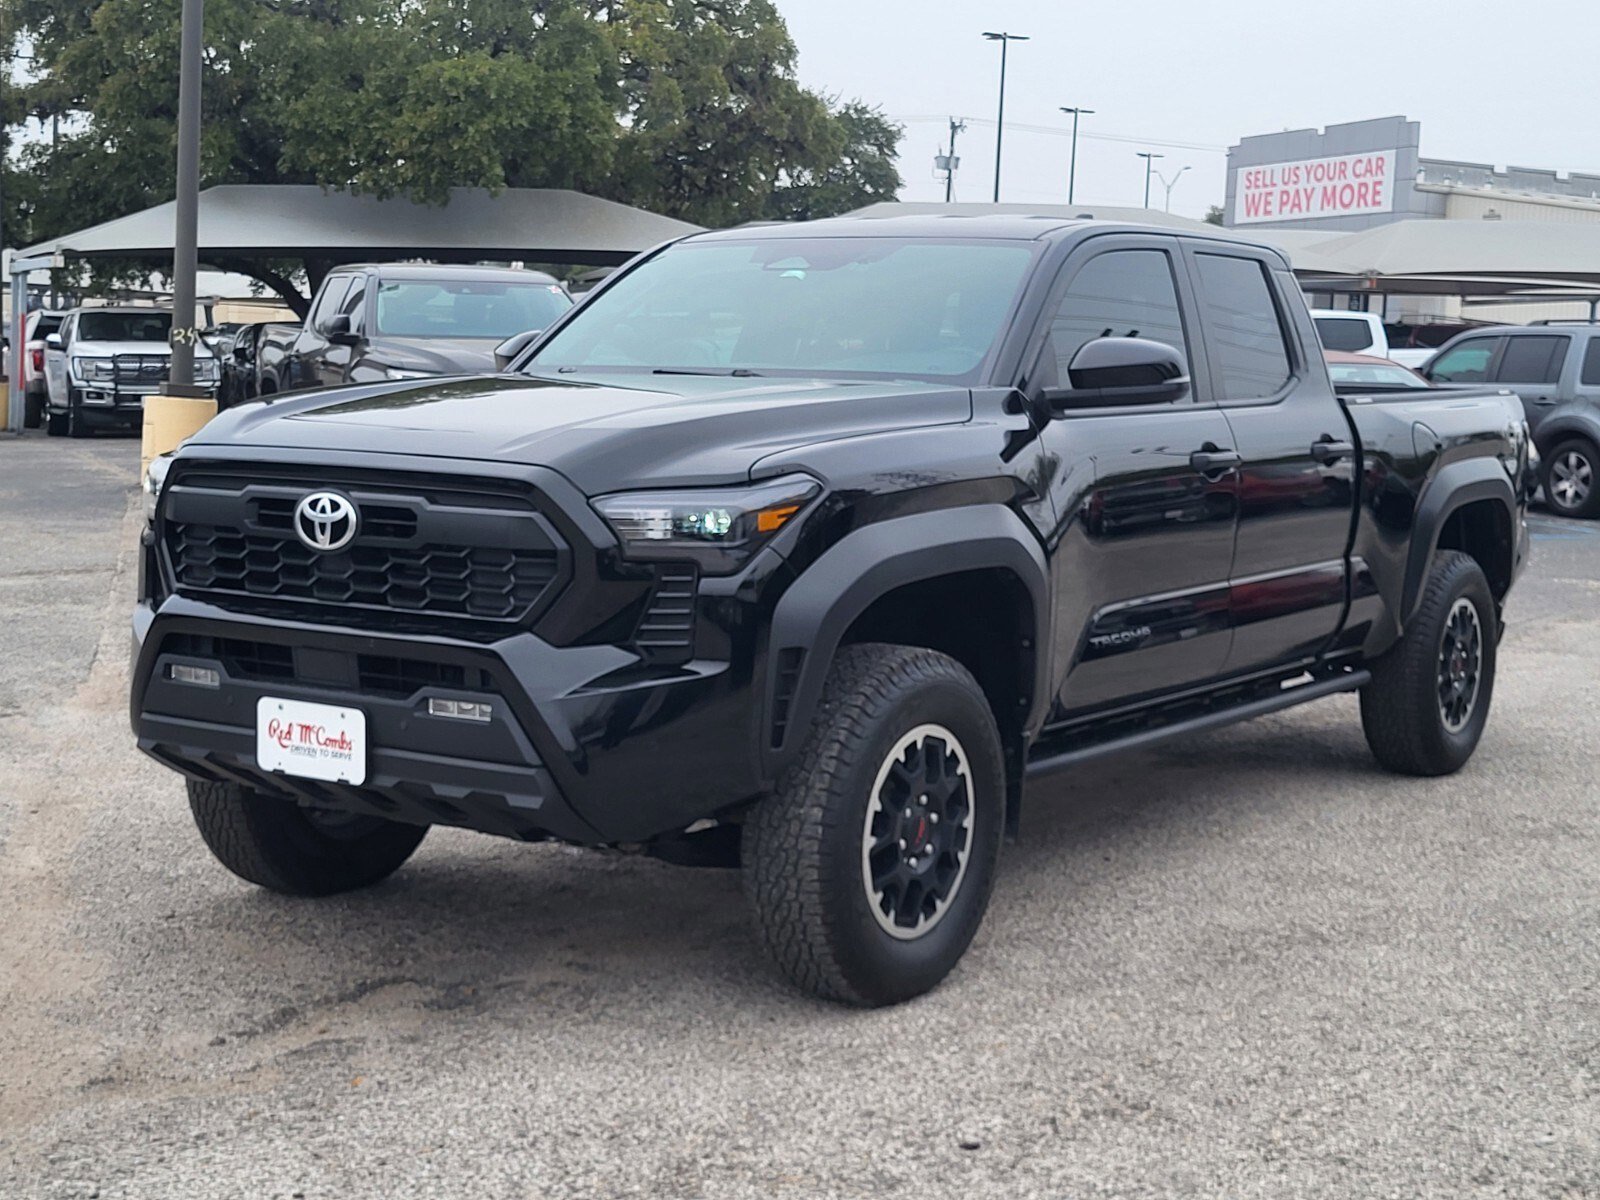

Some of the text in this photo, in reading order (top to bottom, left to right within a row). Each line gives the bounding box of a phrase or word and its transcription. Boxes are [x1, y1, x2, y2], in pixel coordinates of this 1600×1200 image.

[1245, 156, 1385, 190] SELL US YOUR CAR
[1244, 180, 1383, 217] WE PAY MORE
[268, 718, 352, 751] Red McCombs
[290, 744, 352, 761] DRIVEN TO SERVE
